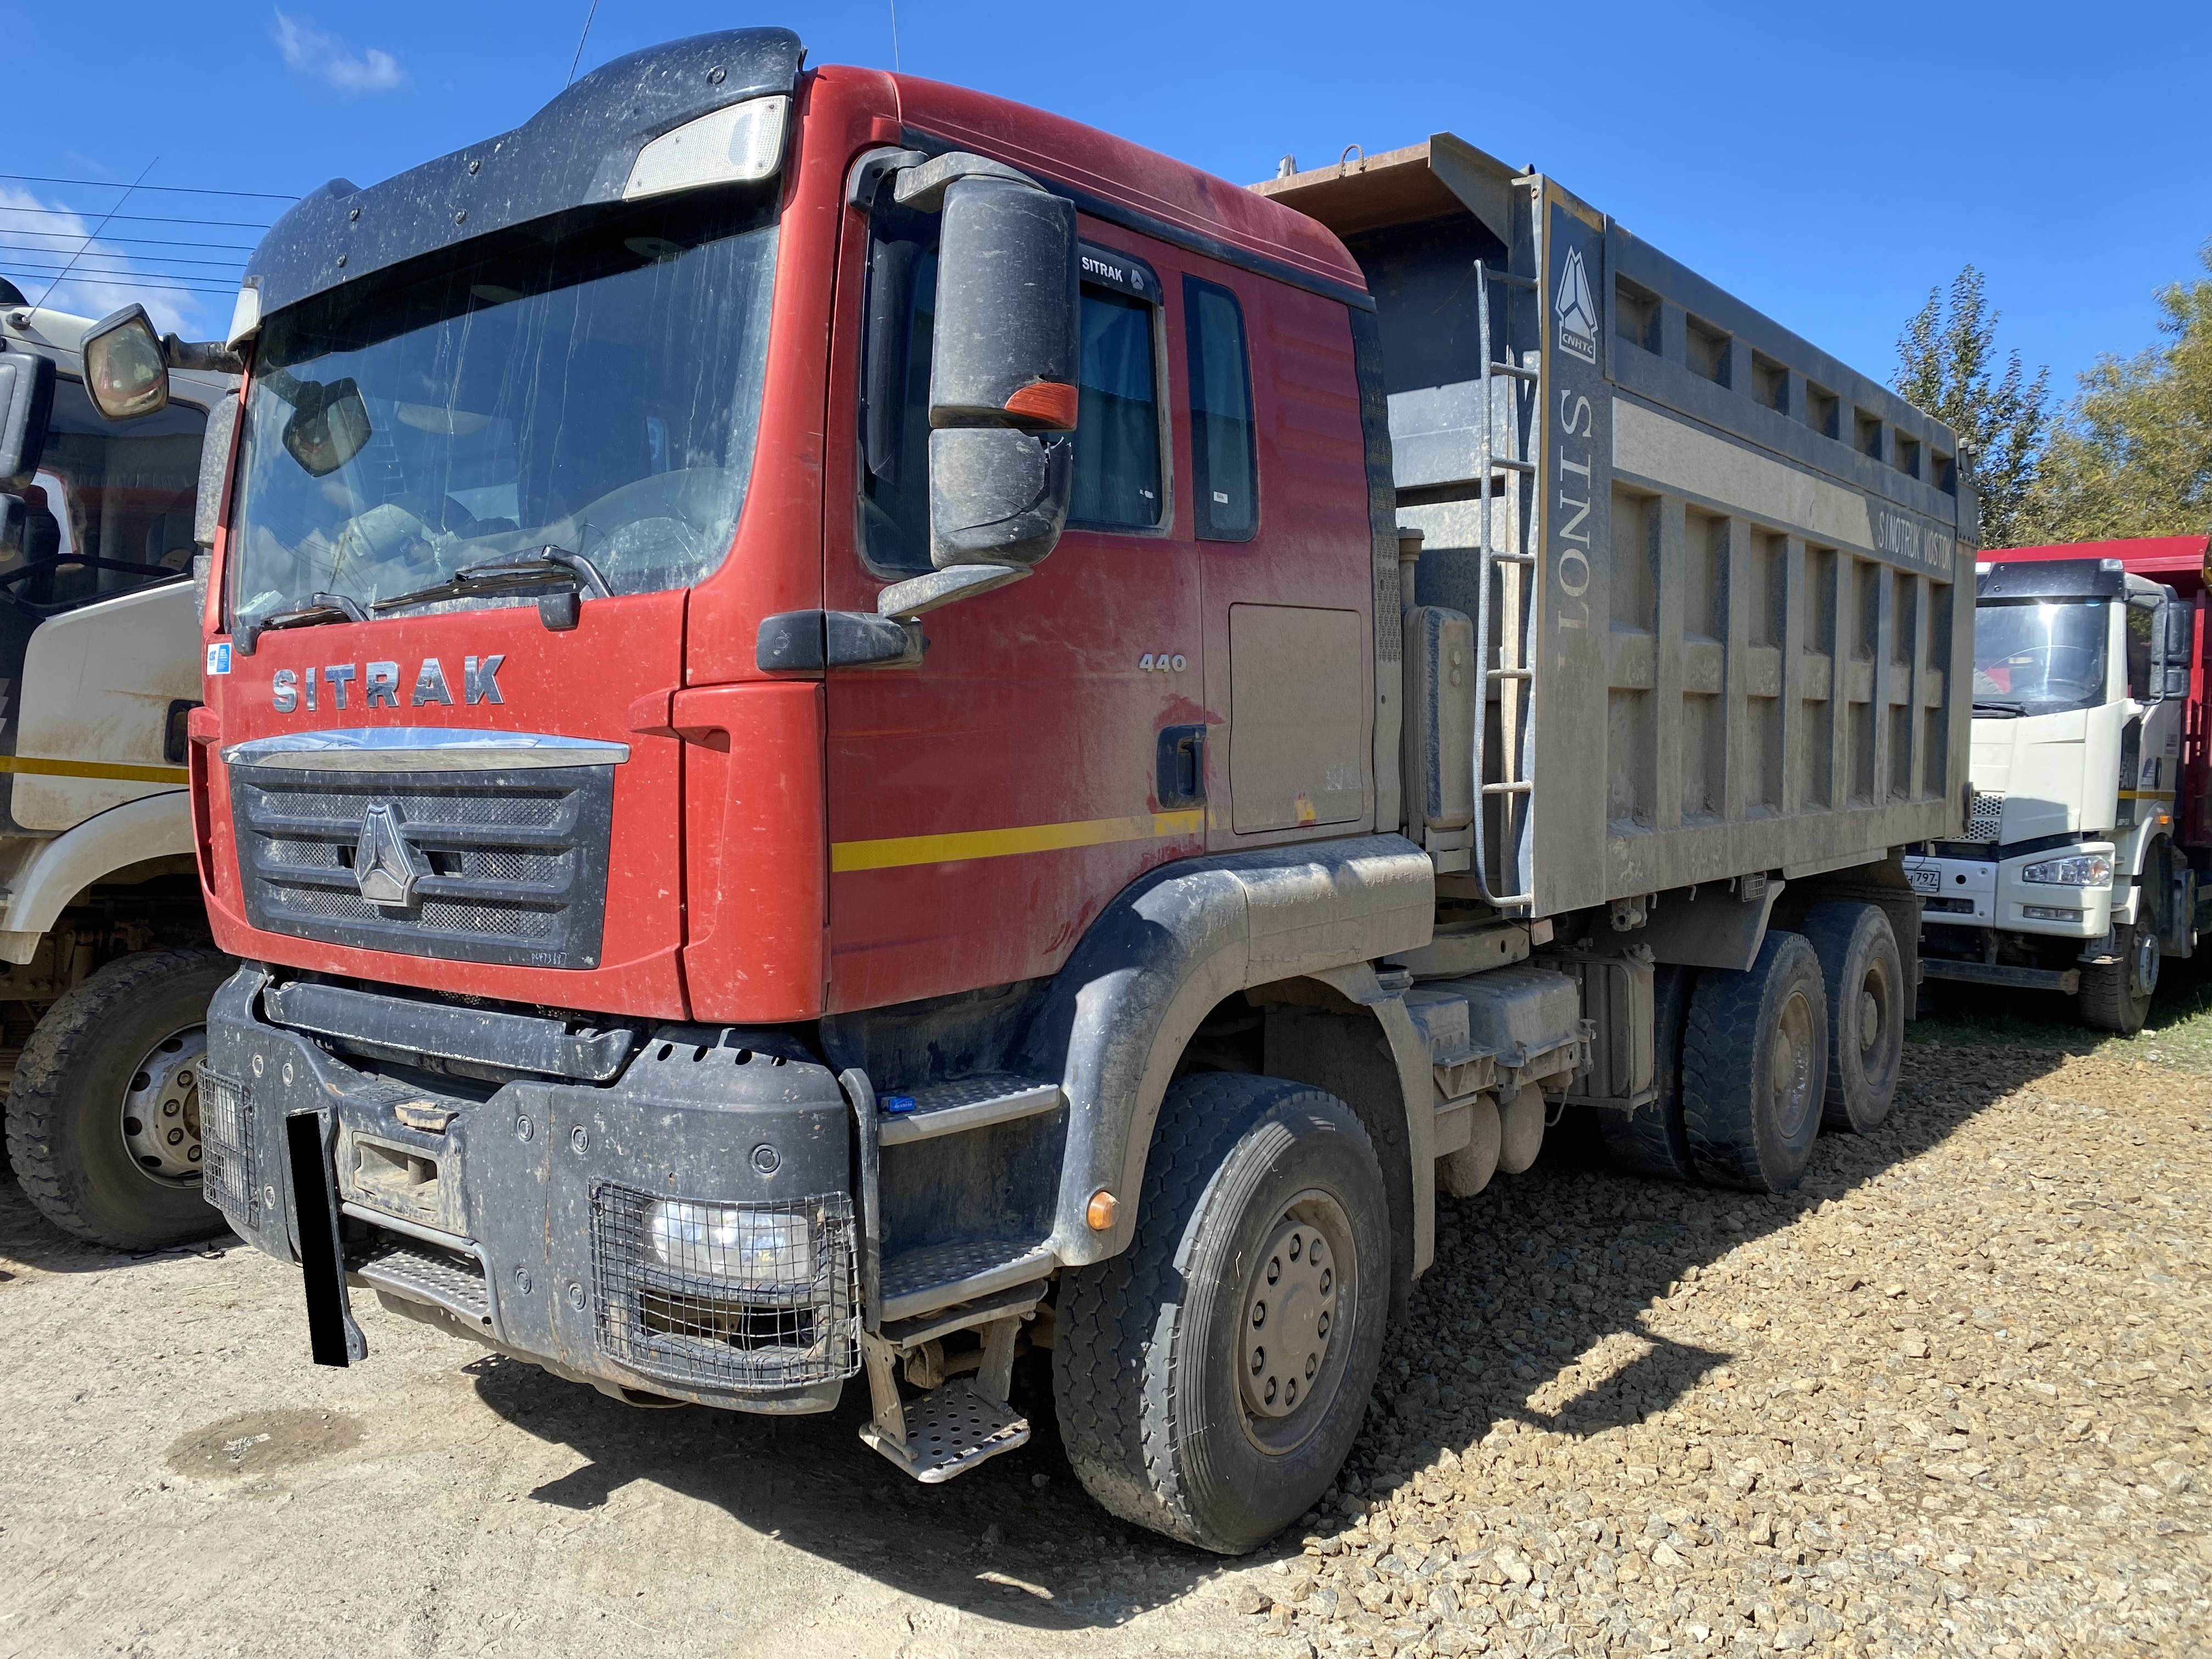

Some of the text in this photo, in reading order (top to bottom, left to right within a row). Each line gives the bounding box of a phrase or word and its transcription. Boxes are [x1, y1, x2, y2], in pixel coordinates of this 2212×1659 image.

[1081, 257, 1123, 283] SITRAK
[1562, 333, 1593, 354] CNHTC
[1558, 388, 1593, 672] SINOT
[1878, 511, 1953, 571] SINOTRUK VOSTOK
[1139, 653, 1187, 672] 440
[272, 654, 505, 713] SITRAK
[1916, 872, 1936, 883] 797
